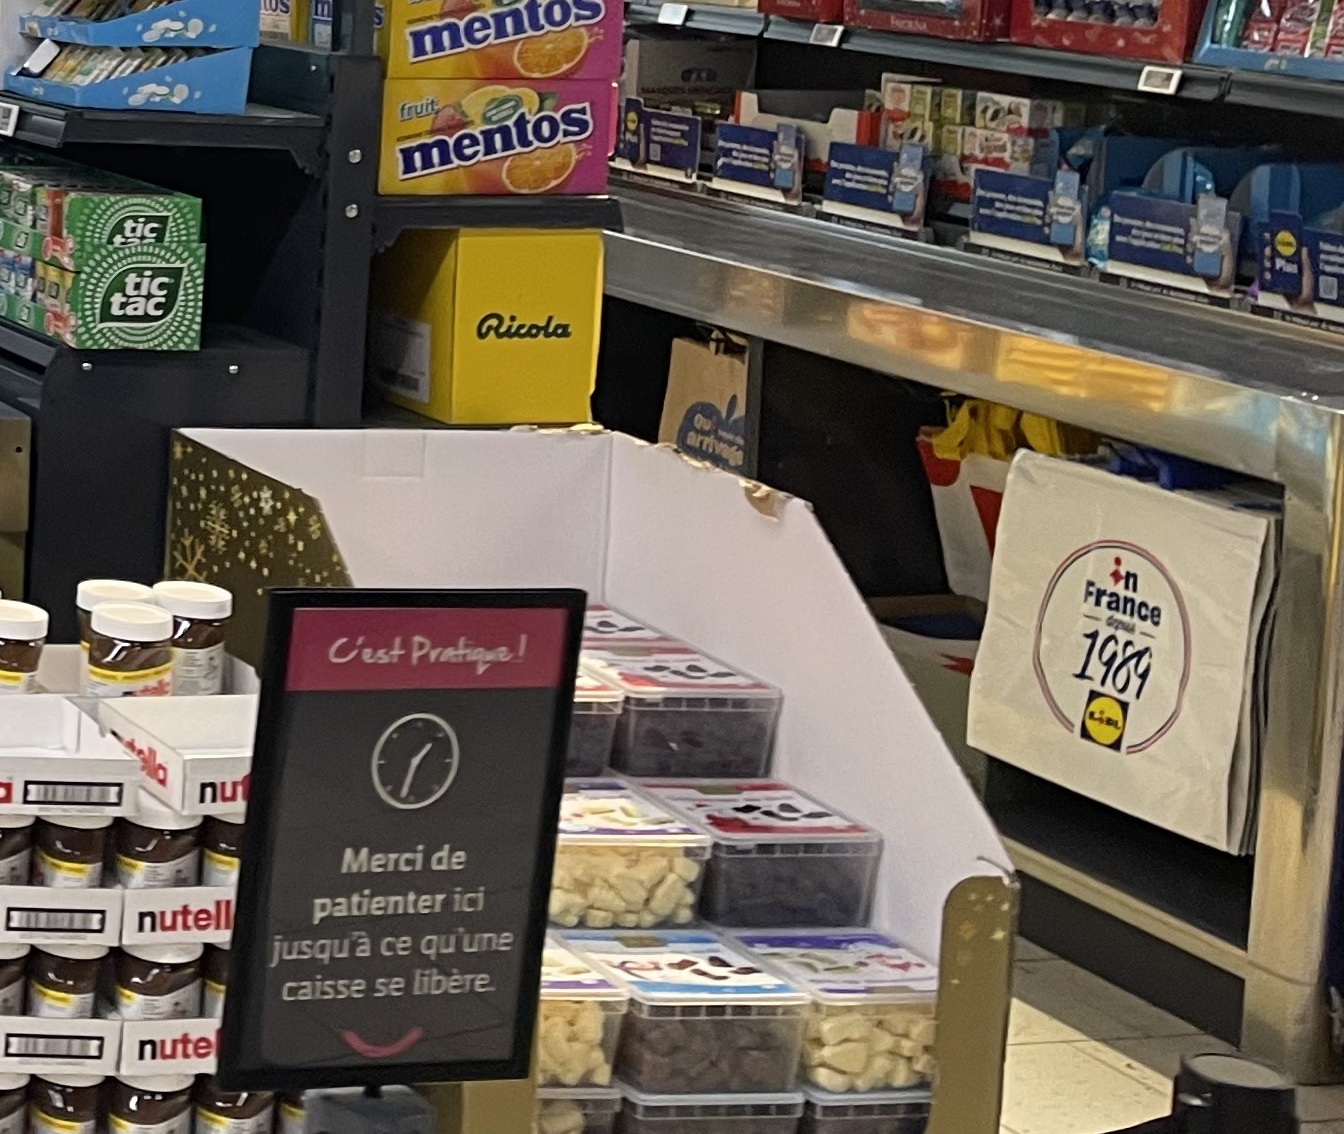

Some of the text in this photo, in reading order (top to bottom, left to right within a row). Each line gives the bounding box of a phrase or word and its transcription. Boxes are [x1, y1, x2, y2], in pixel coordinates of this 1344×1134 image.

[400, 97, 439, 122] fruit
[399, 104, 593, 180] mentos
[123, 217, 160, 238] tic
[124, 270, 175, 297] tic
[110, 291, 167, 317] tac
[476, 312, 572, 340] Ricola
[1084, 579, 1162, 627] France
[328, 634, 406, 665] C'est
[1072, 628, 1154, 701] 1989
[341, 844, 467, 874] Merci de
[138, 899, 234, 933] nutell
[313, 887, 485, 926] patienter ici
[271, 927, 514, 968] jusqu'à ce qu'une
[281, 969, 496, 1001] caisse se libère.
